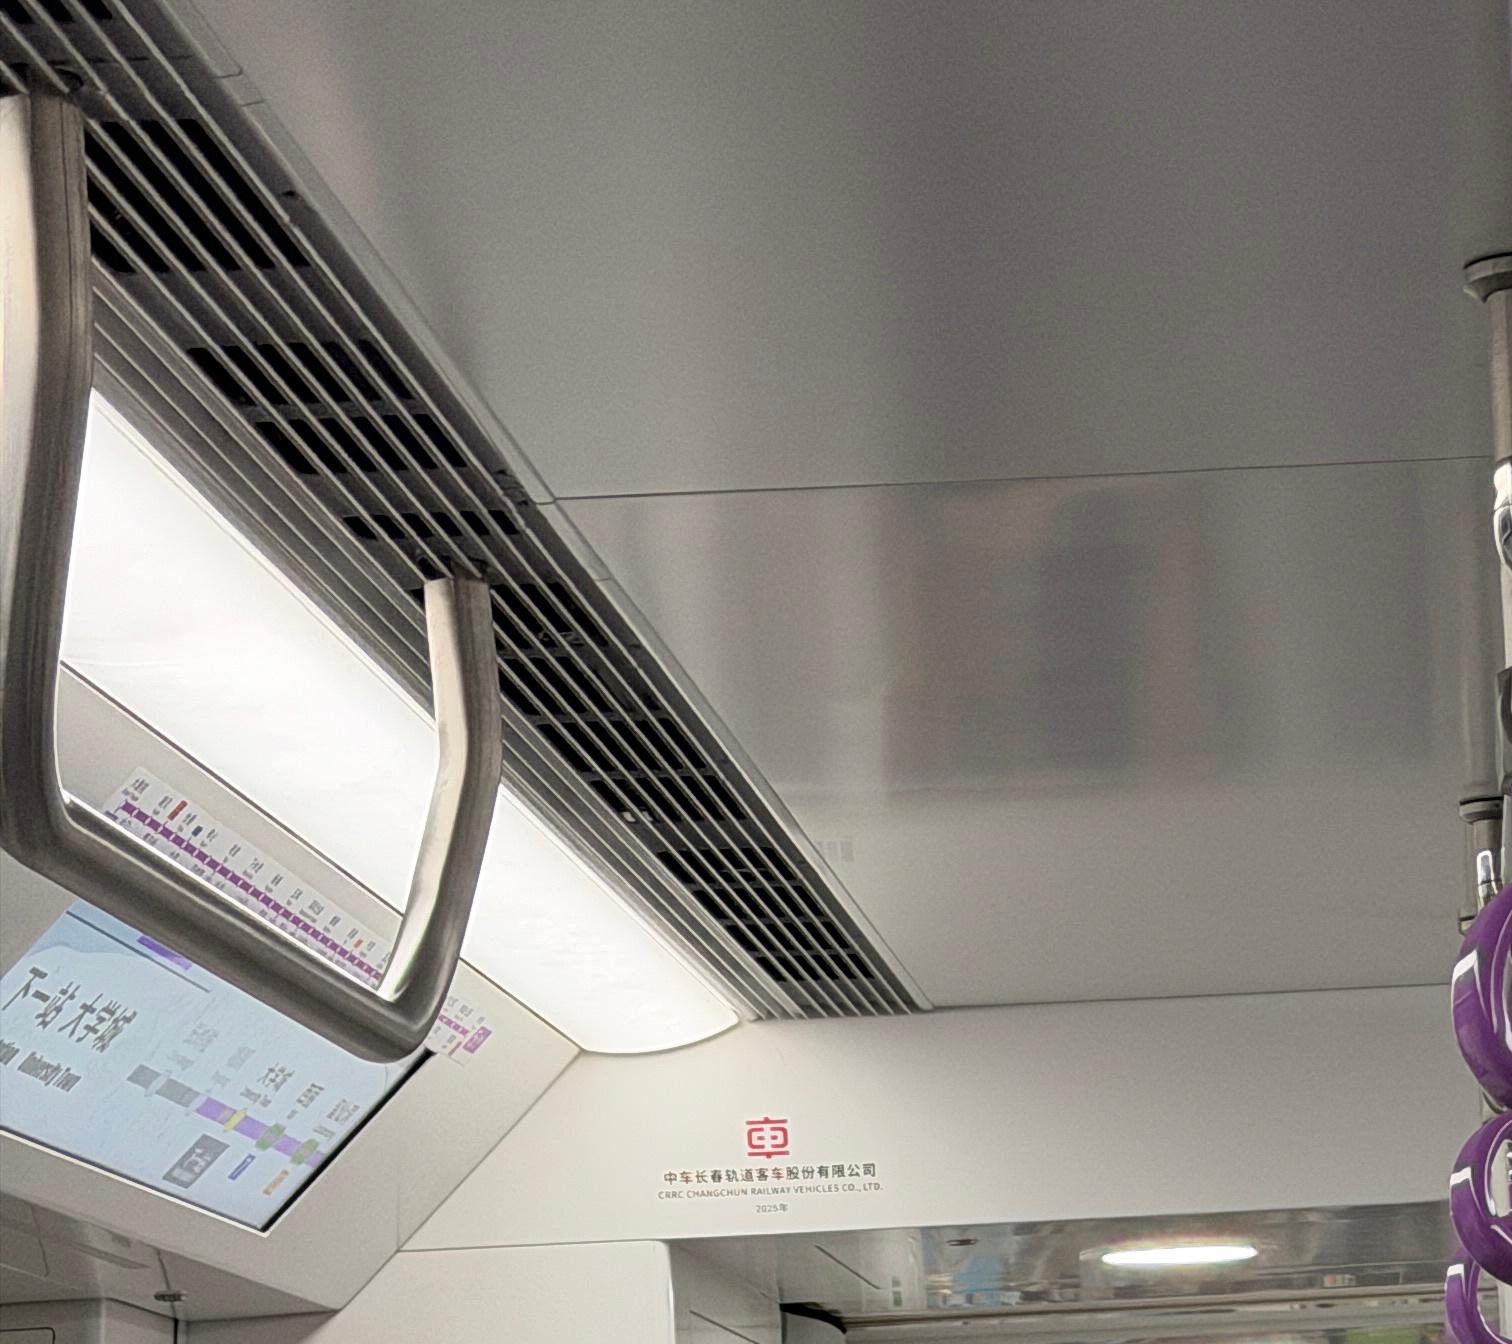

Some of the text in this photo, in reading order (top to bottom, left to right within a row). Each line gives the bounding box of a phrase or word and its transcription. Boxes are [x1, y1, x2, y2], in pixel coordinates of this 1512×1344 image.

[1, 966, 81, 1031] 下一站
[57, 992, 138, 1054] 大学城
[663, 1162, 877, 1186] 中车长春轨道客车股份有限公司
[658, 1189, 684, 1200] CRRC
[686, 1187, 748, 1199] CHANGCHUN
[750, 1185, 791, 1197] RAILWAY
[793, 1183, 840, 1195] VEHICLES
[755, 1203, 788, 1214] 2025年
